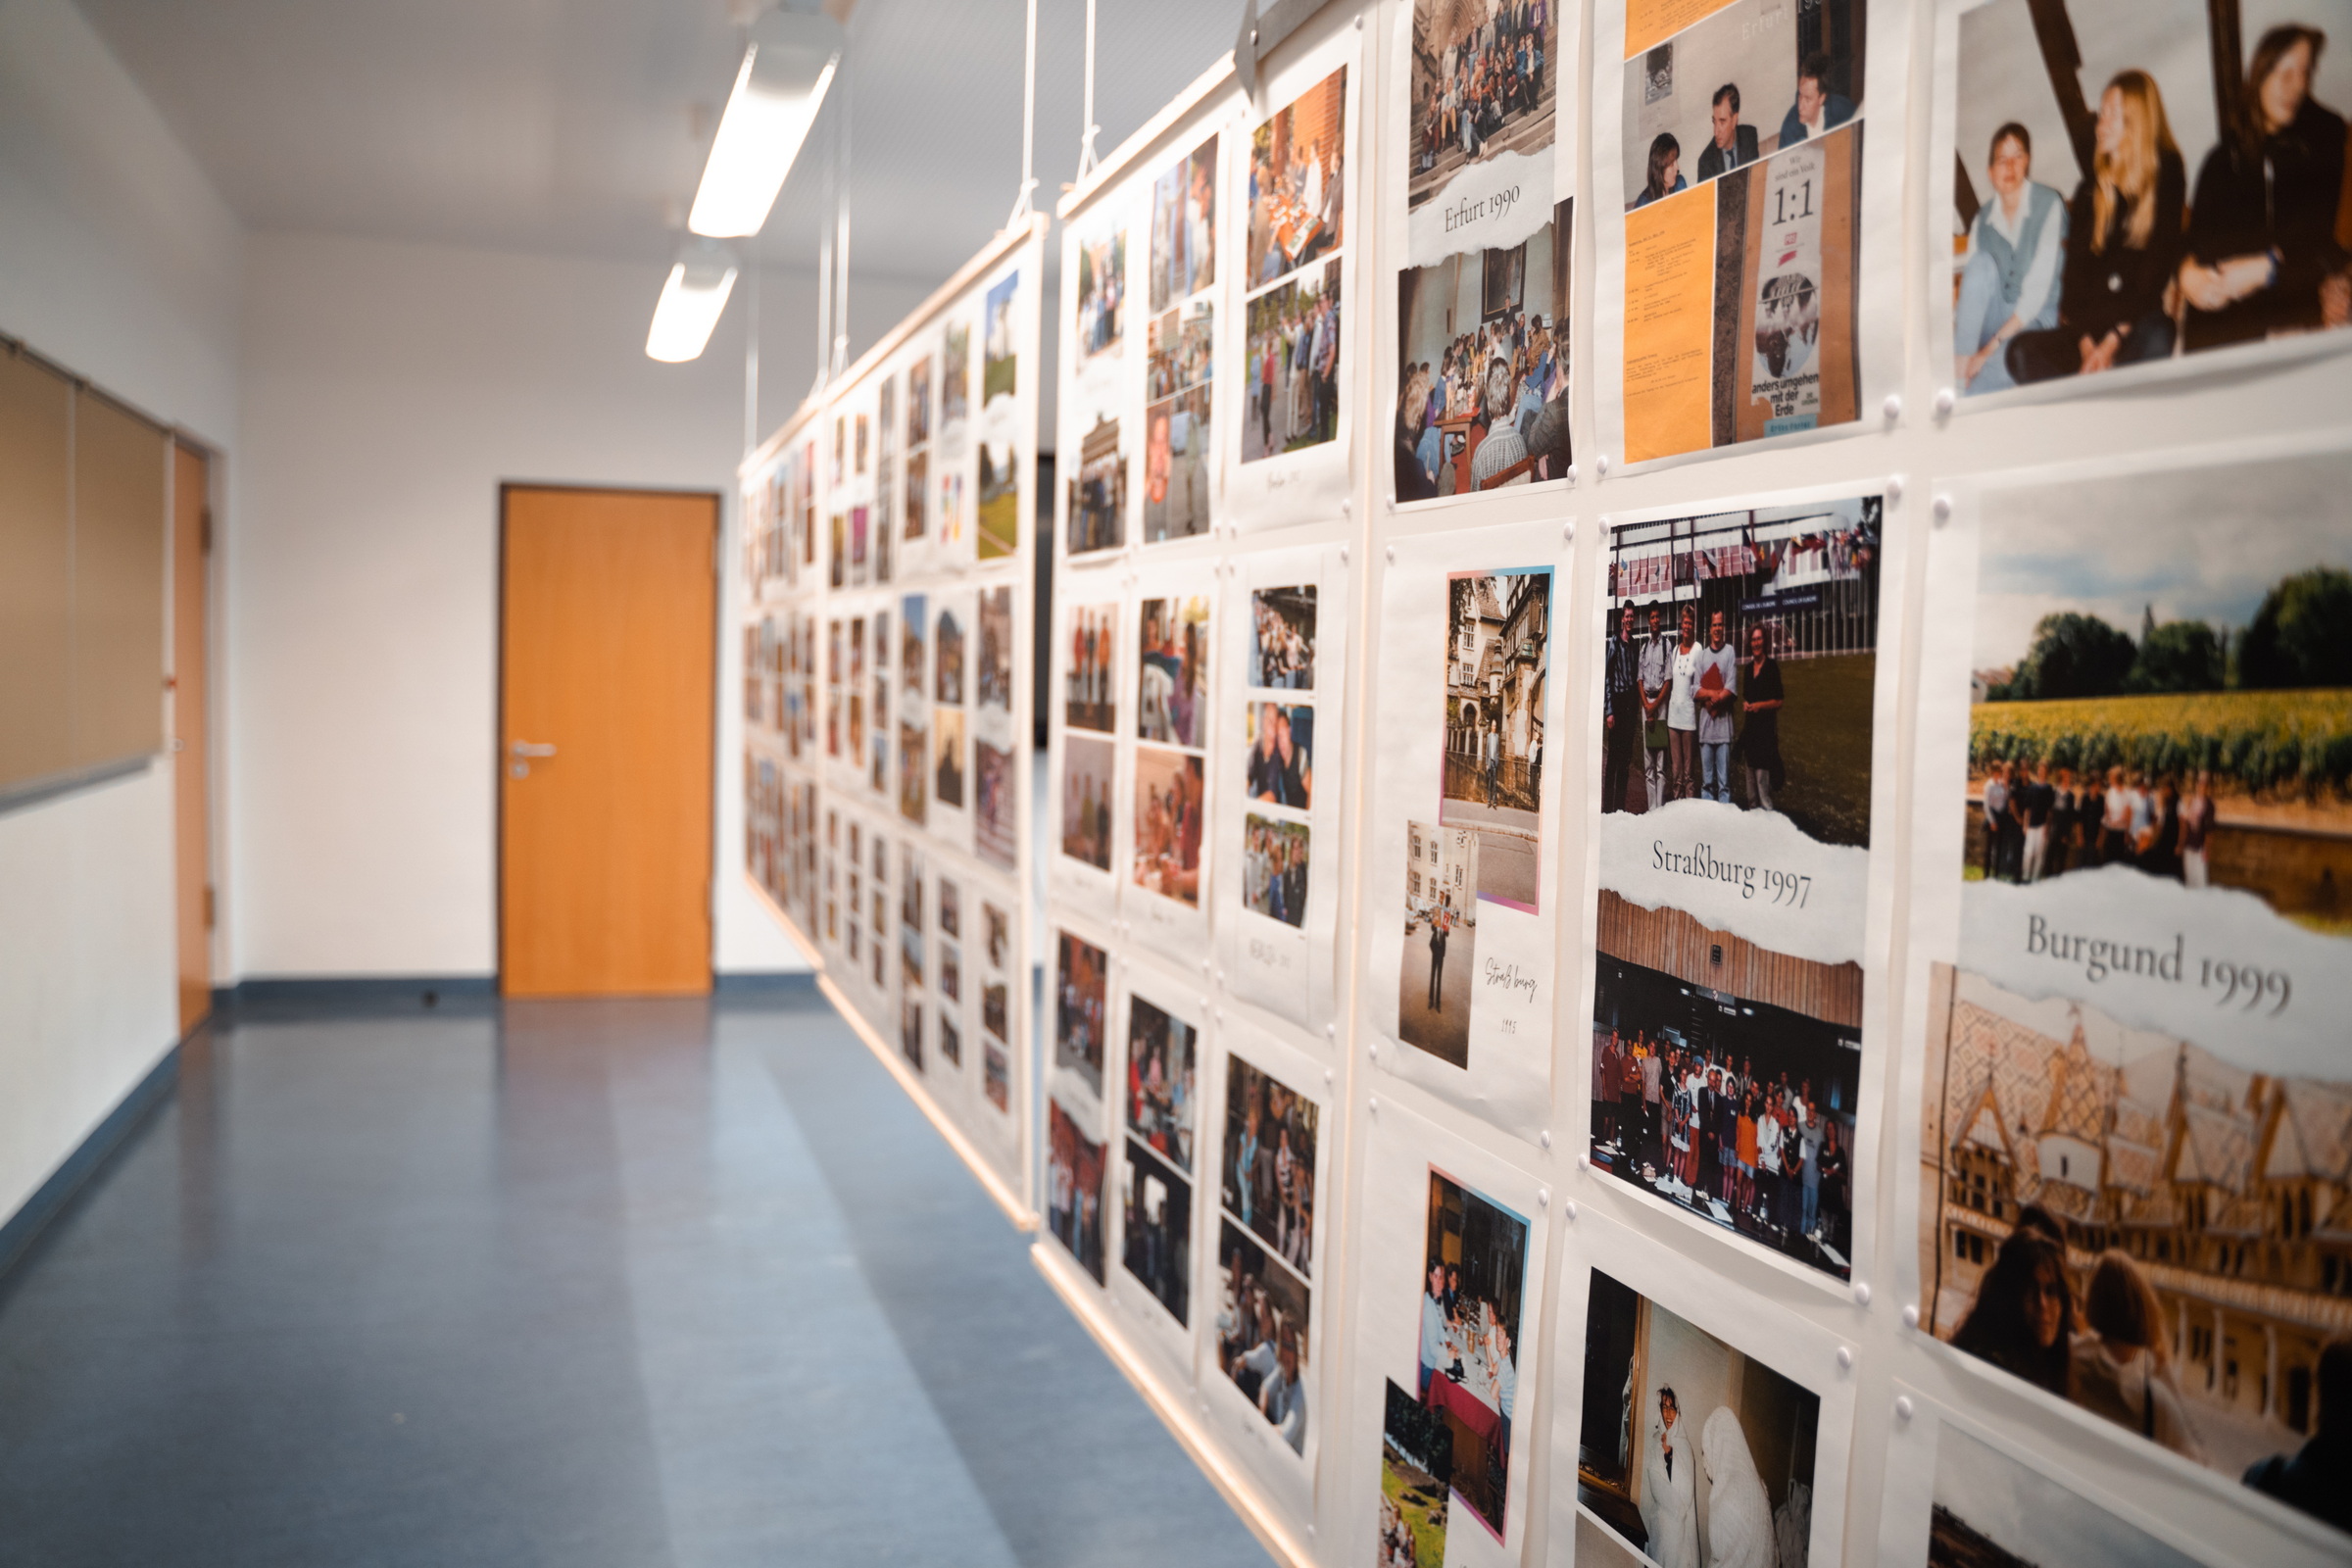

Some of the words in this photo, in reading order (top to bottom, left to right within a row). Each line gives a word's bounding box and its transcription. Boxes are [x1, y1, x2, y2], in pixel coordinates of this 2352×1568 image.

[1445, 197, 1486, 233] Erfurt
[1489, 185, 1520, 221] 1990
[1772, 178, 1813, 226] 1:1
[1751, 380, 1780, 394] anders
[1781, 373, 1820, 390] umgehen
[1770, 391, 1784, 404] mit
[1785, 389, 1799, 402] der
[1775, 402, 1794, 417] Erde
[1652, 840, 1756, 900] Straßburg
[1762, 868, 1812, 909] 1997
[1485, 956, 1539, 1004] Straßburg
[2026, 913, 2185, 983] Burgund
[2200, 957, 2293, 1017] 1999
[1500, 1018, 1518, 1035] 1995
